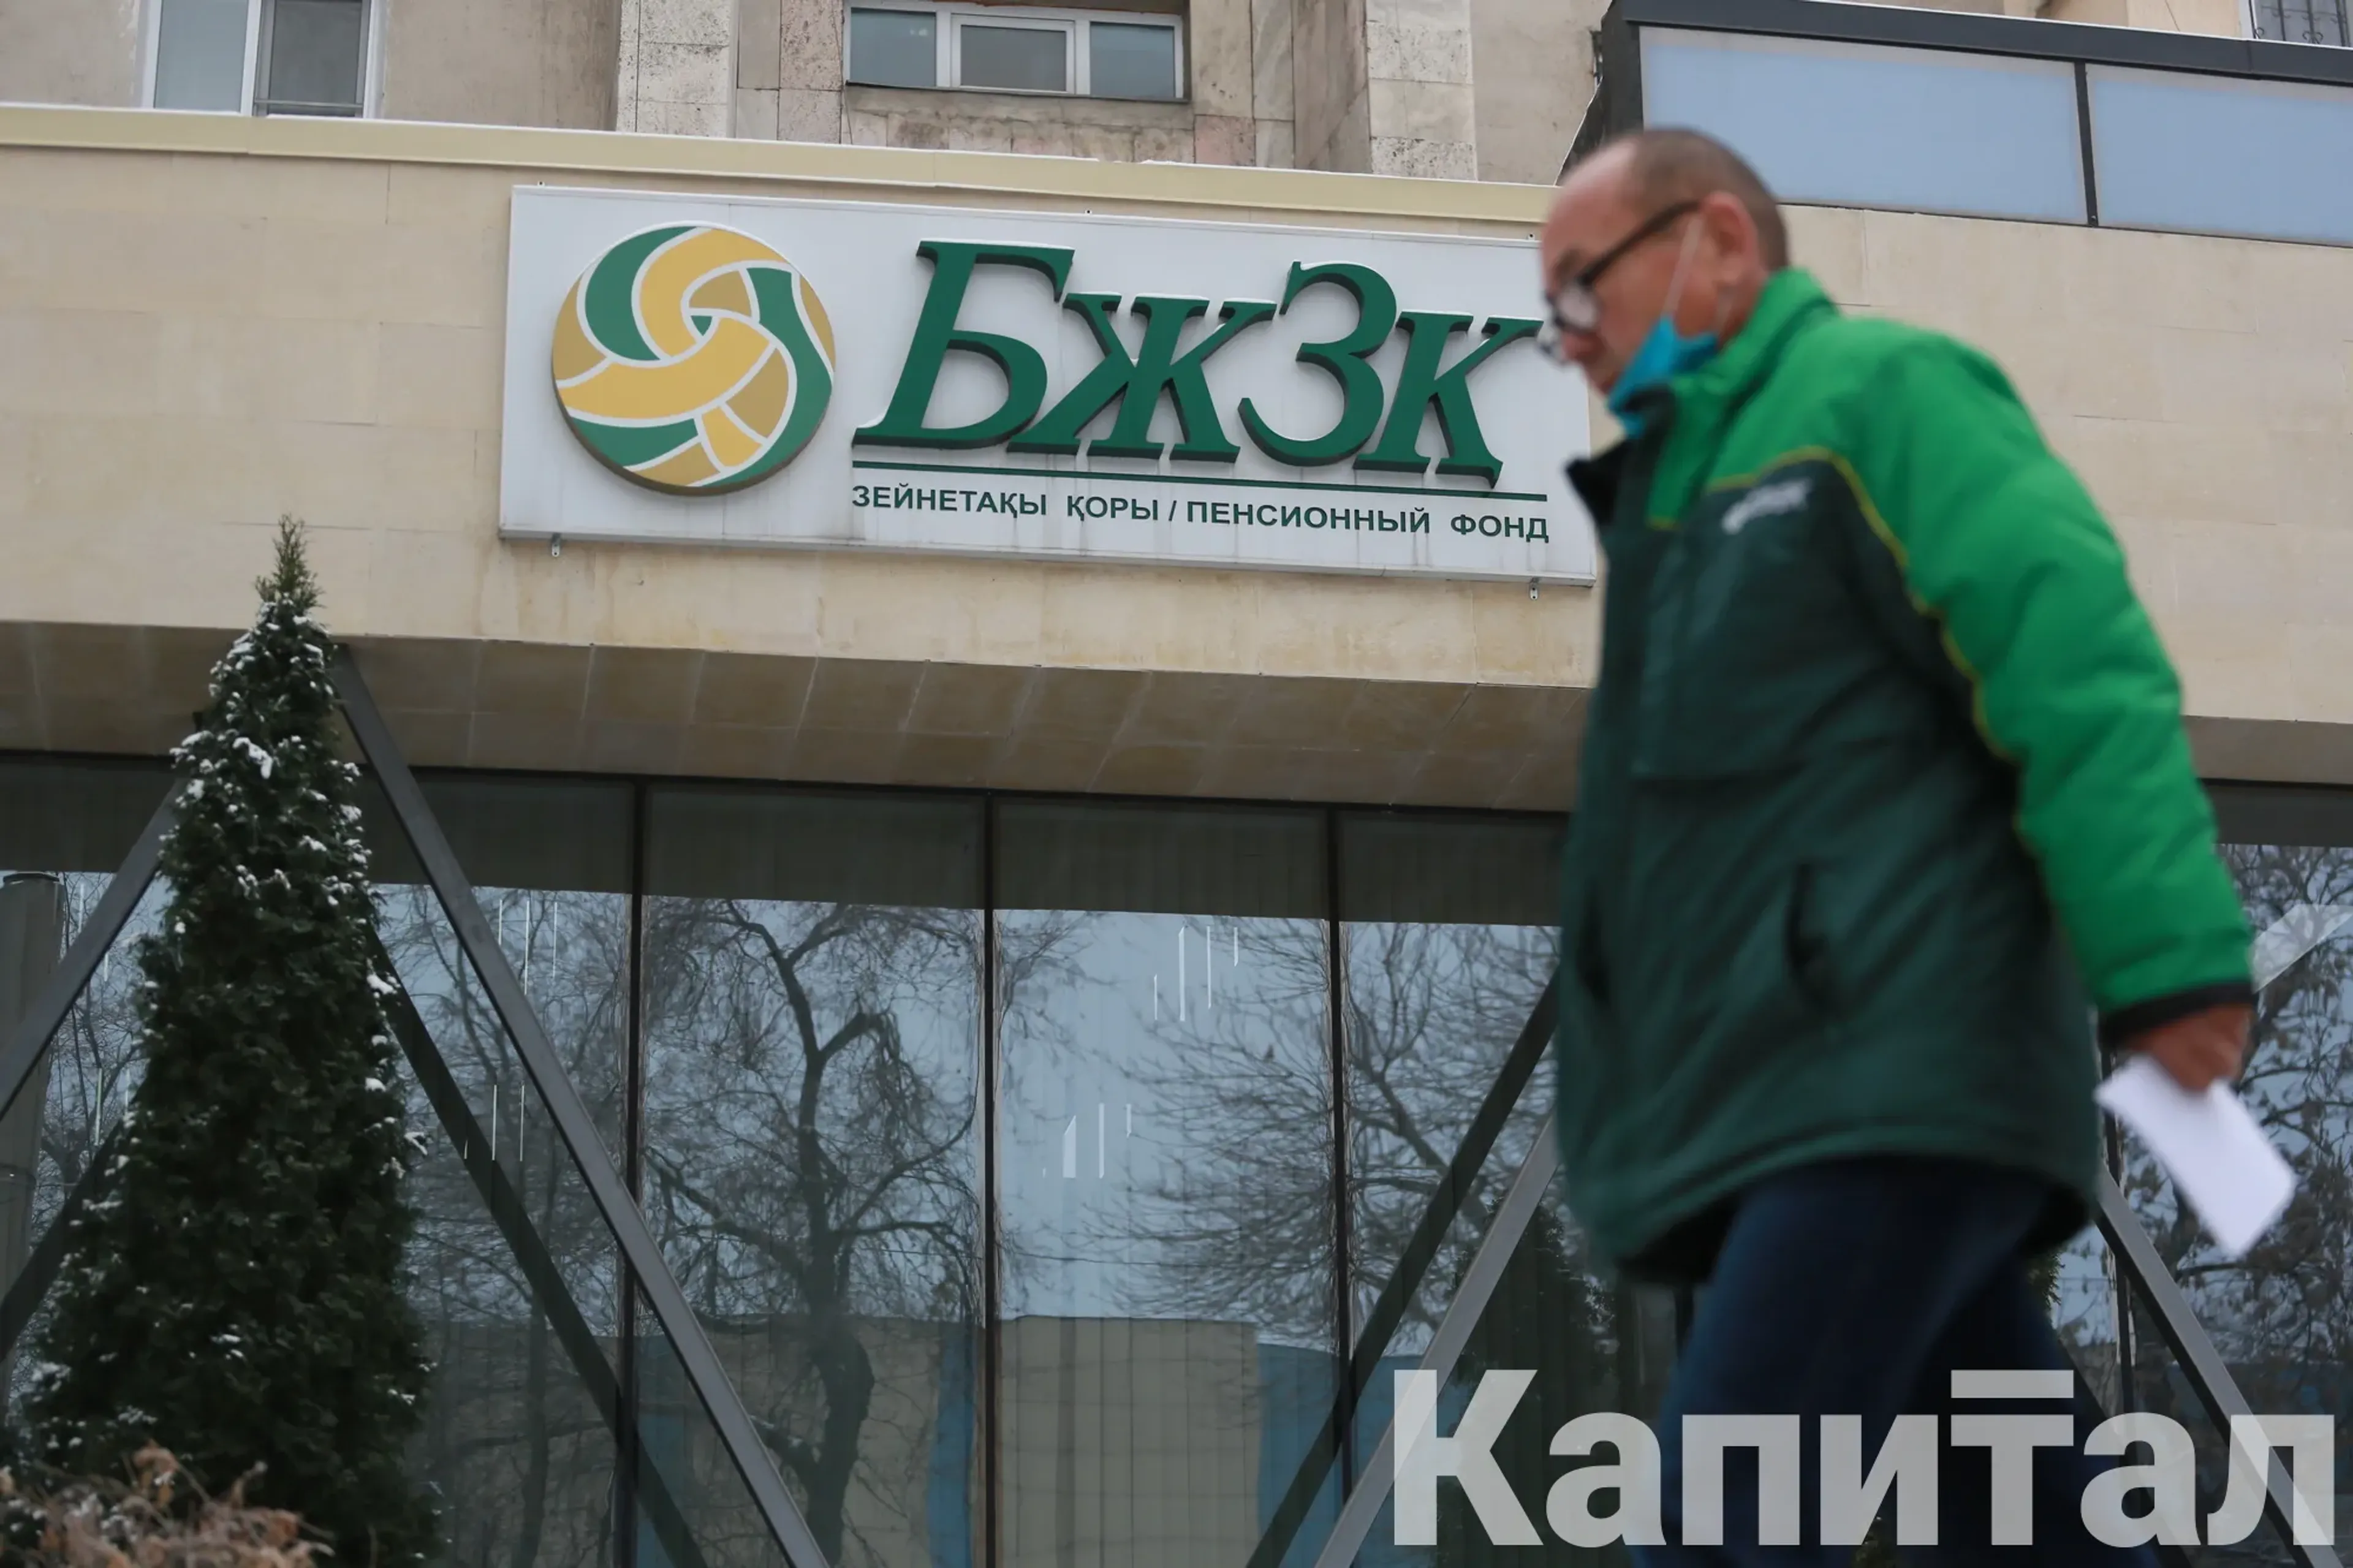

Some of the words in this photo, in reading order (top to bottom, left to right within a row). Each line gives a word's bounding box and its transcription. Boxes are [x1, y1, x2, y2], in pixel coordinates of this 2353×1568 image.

[852, 483, 1047, 518] ЗЕЙНЕТАҚЫ
[1066, 495, 1158, 521] ҚОРЫ
[1186, 501, 1430, 534] ПЕНСИОННЫЙ
[1450, 514, 1550, 543] ФОНД
